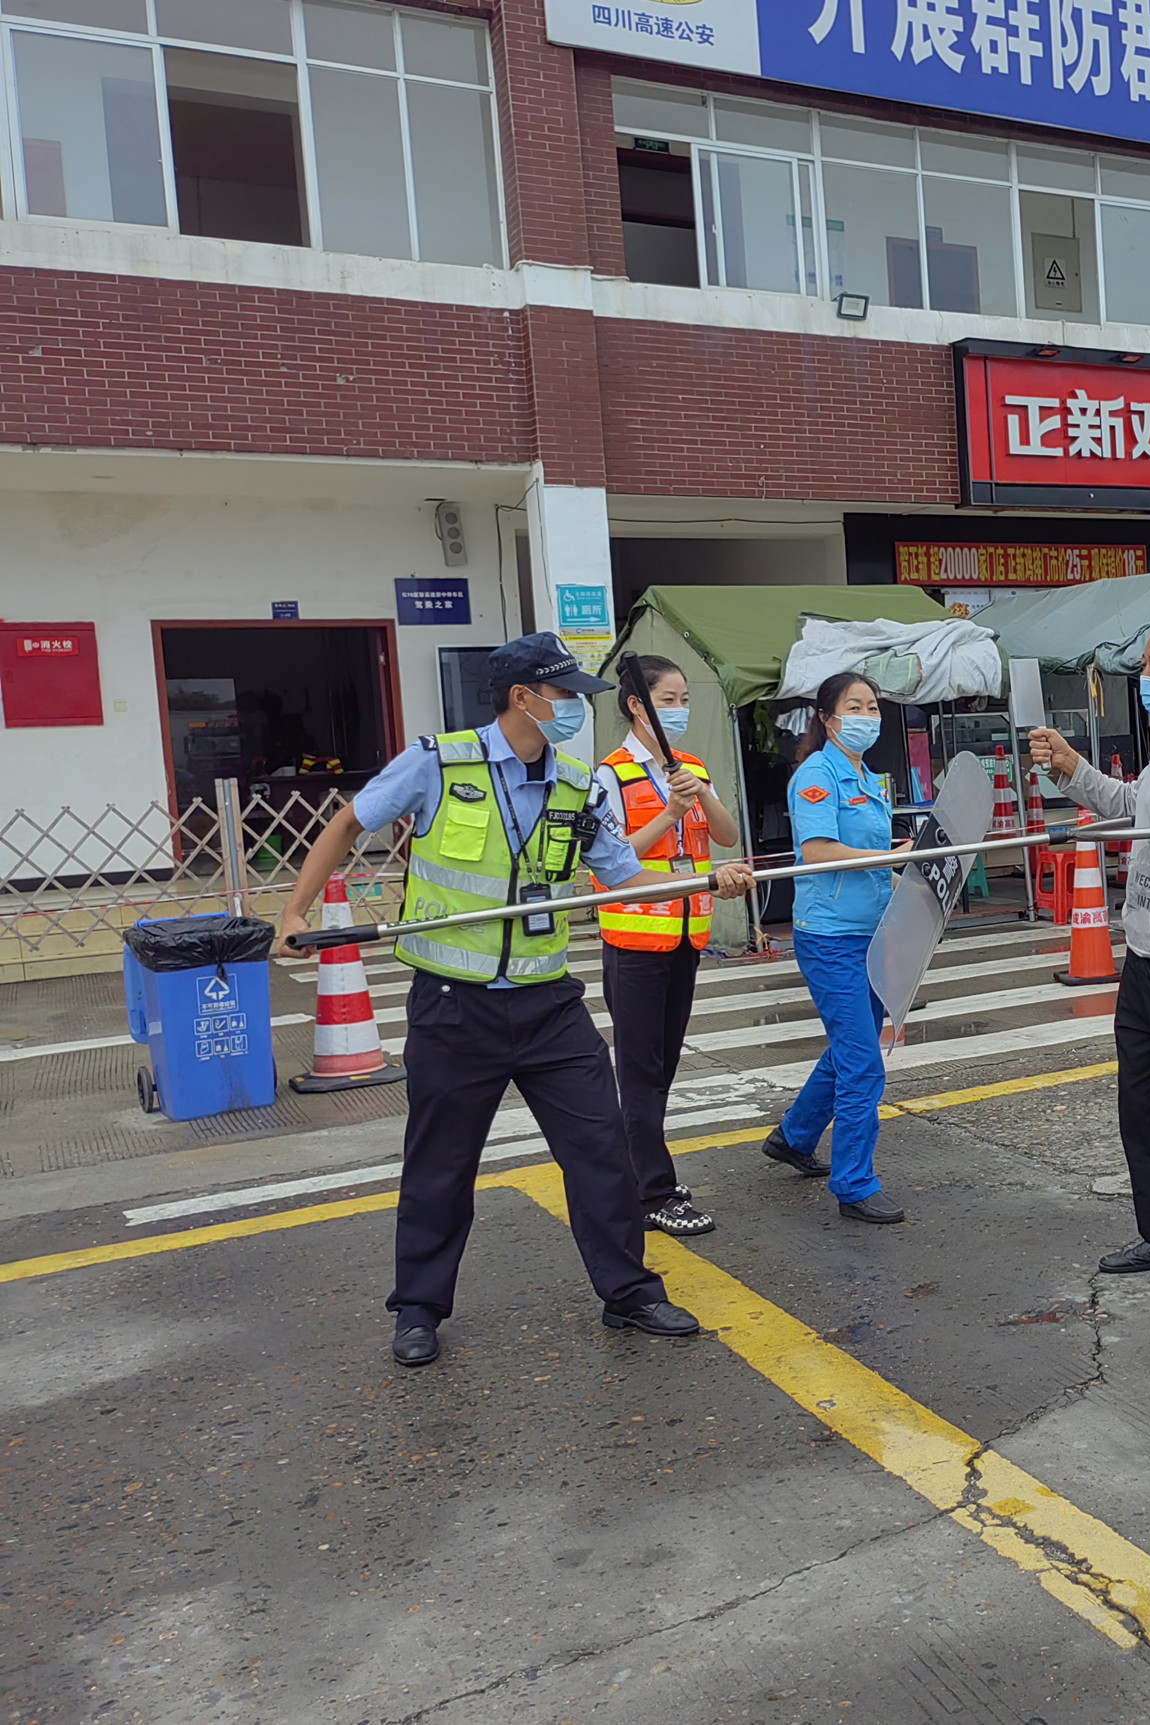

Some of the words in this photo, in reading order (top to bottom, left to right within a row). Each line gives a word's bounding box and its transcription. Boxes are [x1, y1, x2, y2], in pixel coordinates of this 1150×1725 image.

[592, 5, 714, 46] 四川高速公安
[930, 546, 1005, 581] 超20000家门店
[40, 640, 73, 649] 消火栓
